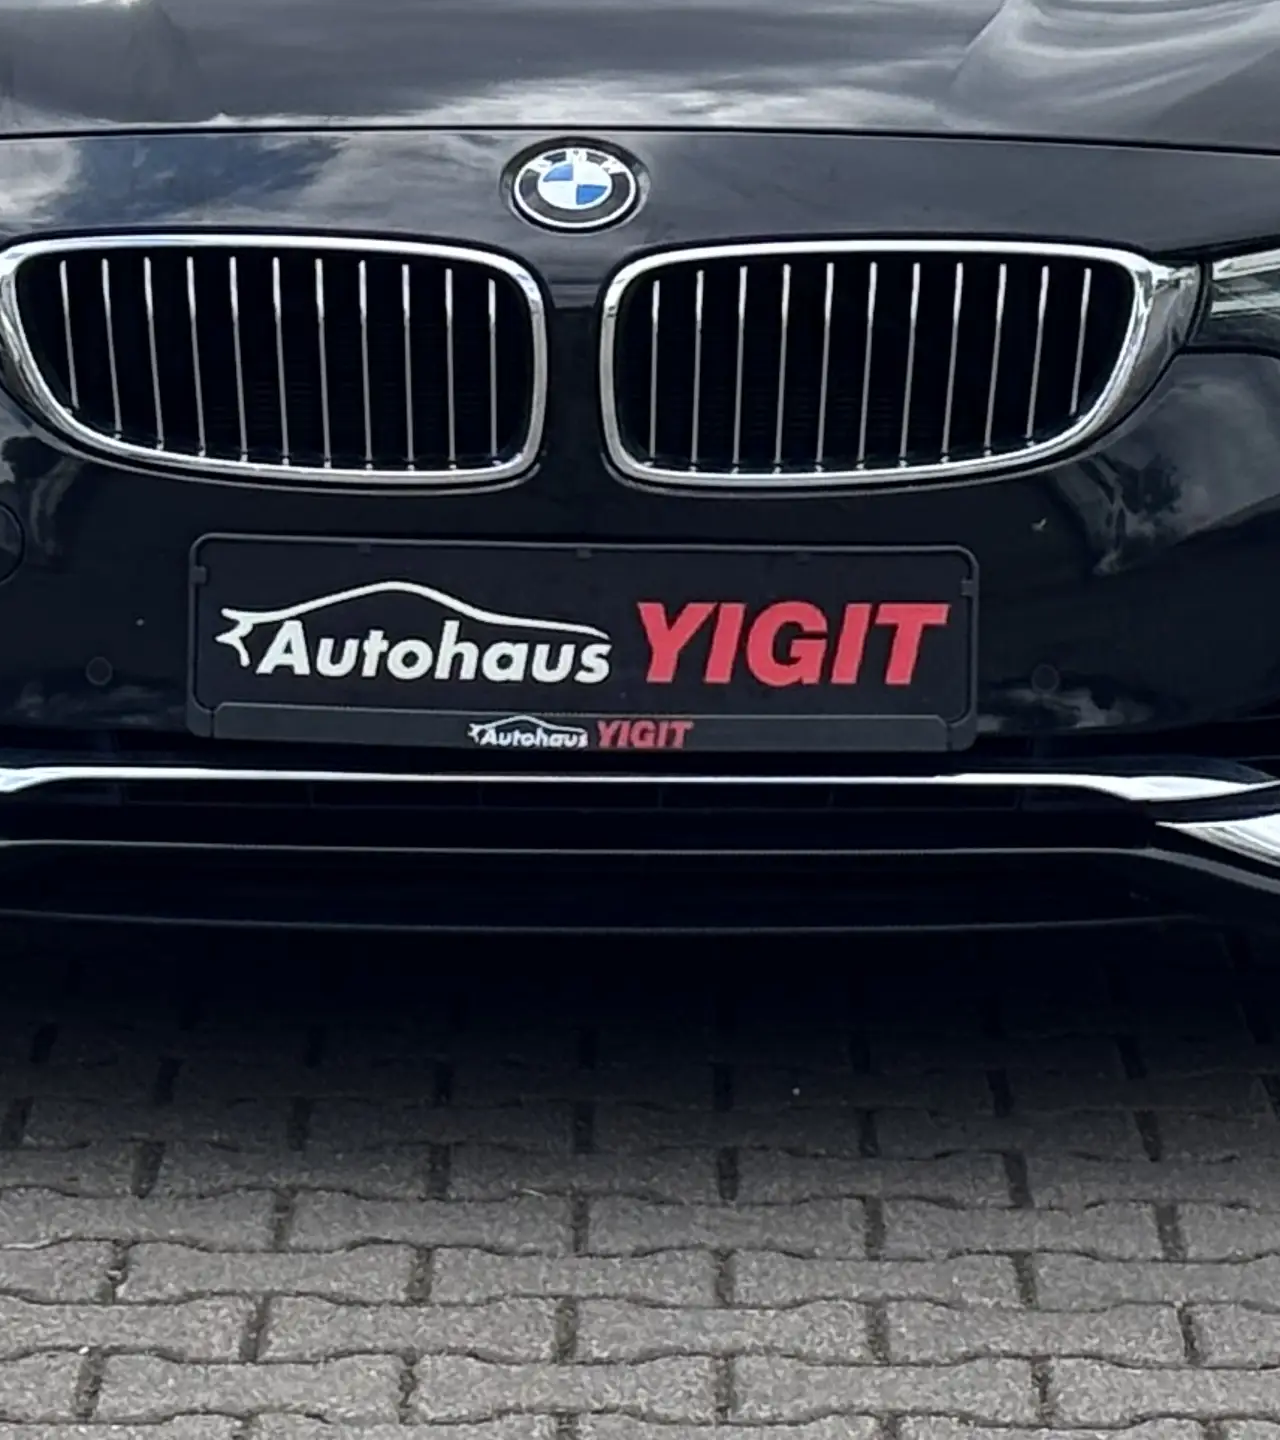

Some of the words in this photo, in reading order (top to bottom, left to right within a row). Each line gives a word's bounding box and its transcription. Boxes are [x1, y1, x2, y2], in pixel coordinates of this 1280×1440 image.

[257, 619, 611, 684] Autohaus
[637, 602, 950, 686] YIGIT
[480, 725, 589, 748] Autohaus
[597, 720, 694, 748] YIGIT
